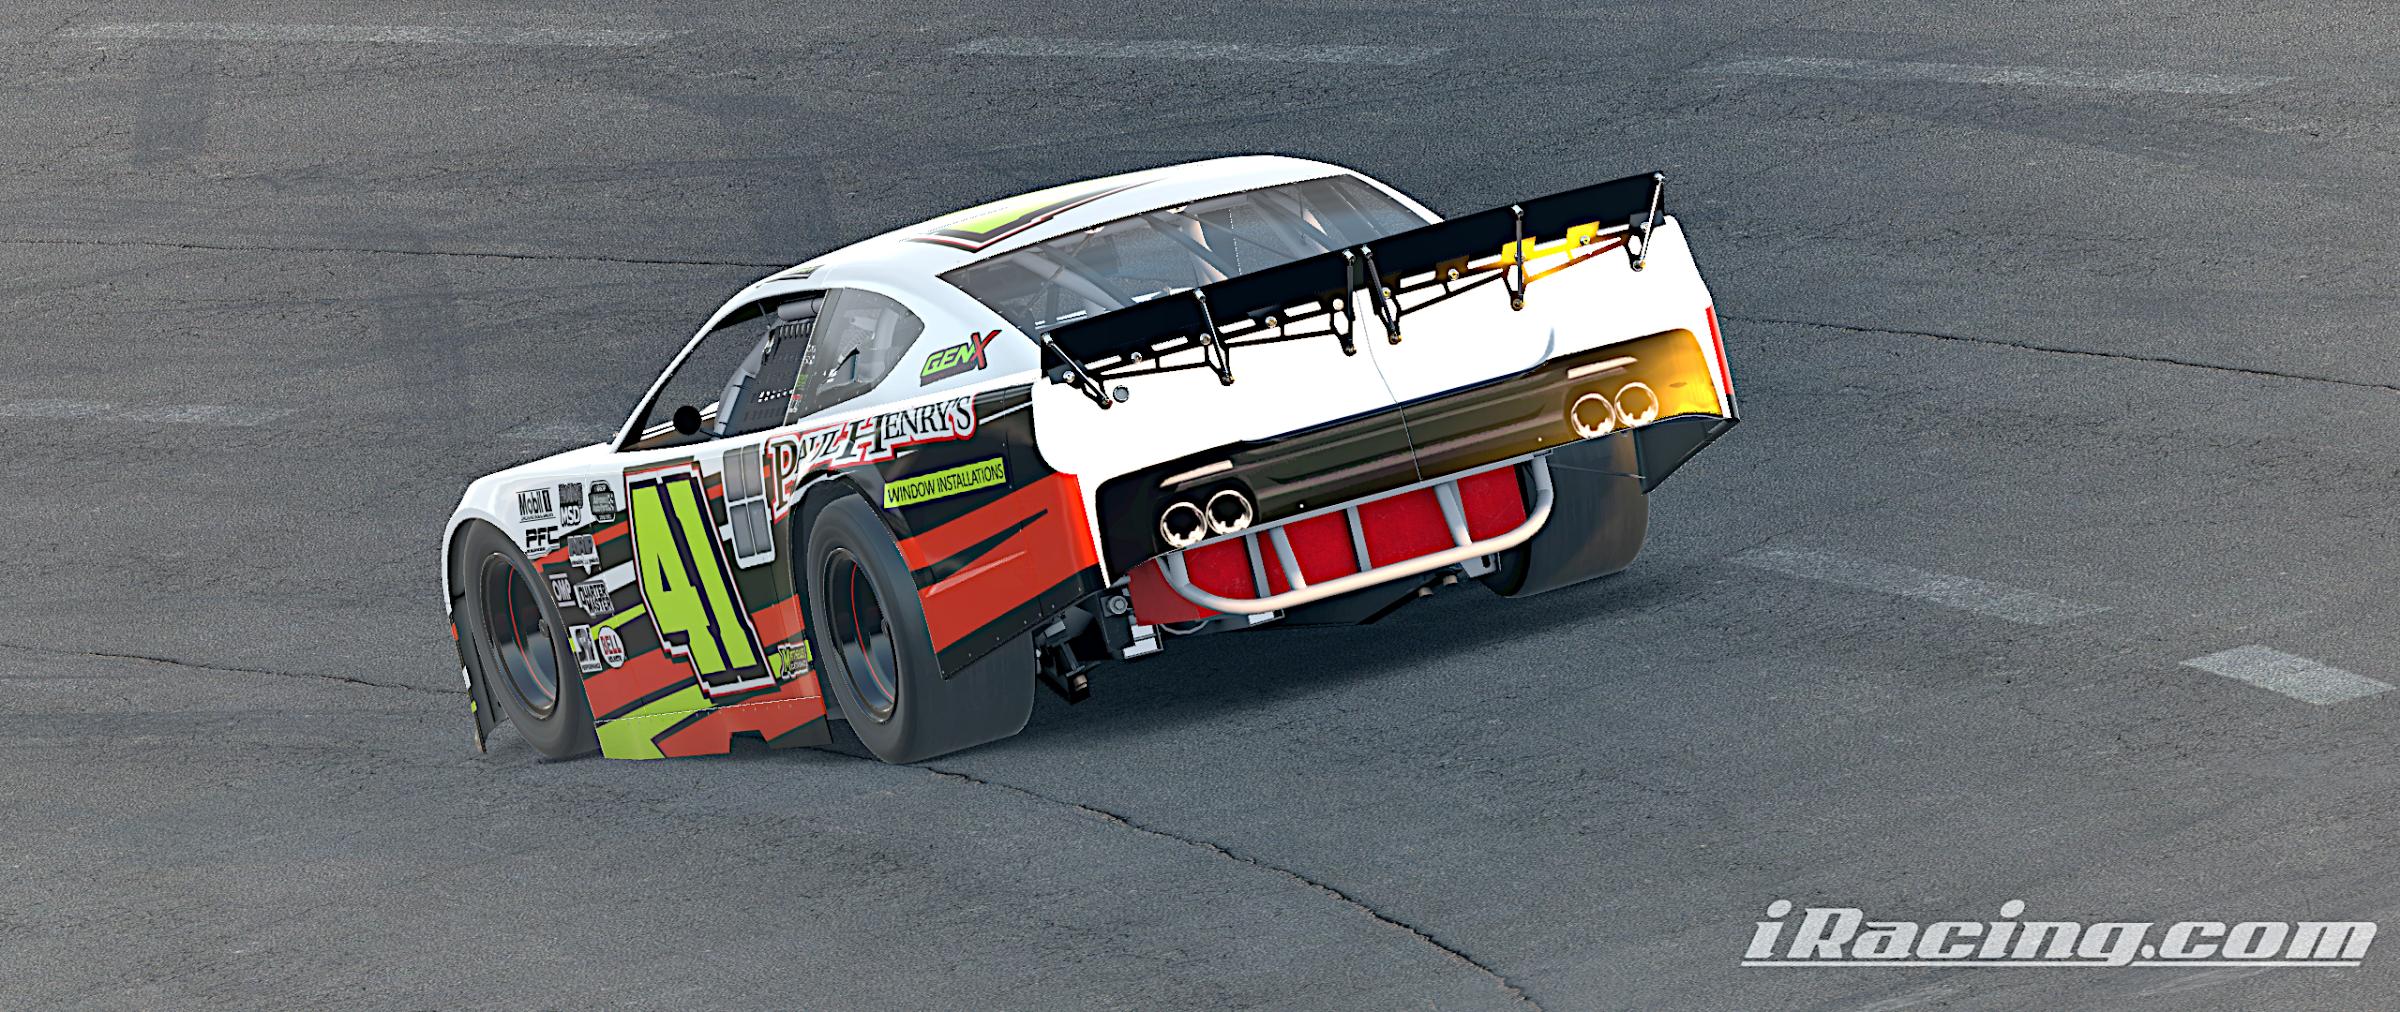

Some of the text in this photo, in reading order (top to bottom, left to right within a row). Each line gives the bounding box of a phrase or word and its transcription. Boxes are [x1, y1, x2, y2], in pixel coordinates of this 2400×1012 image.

[835, 395, 973, 460] HENRY'S
[887, 463, 1004, 503] WINDOW INSTALLATIONS
[518, 491, 544, 515] Mobil
[560, 505, 582, 527] MSD
[526, 526, 559, 547] PFC
[631, 477, 757, 674] 41
[551, 579, 572, 602] OMP
[600, 635, 622, 655] BELL
